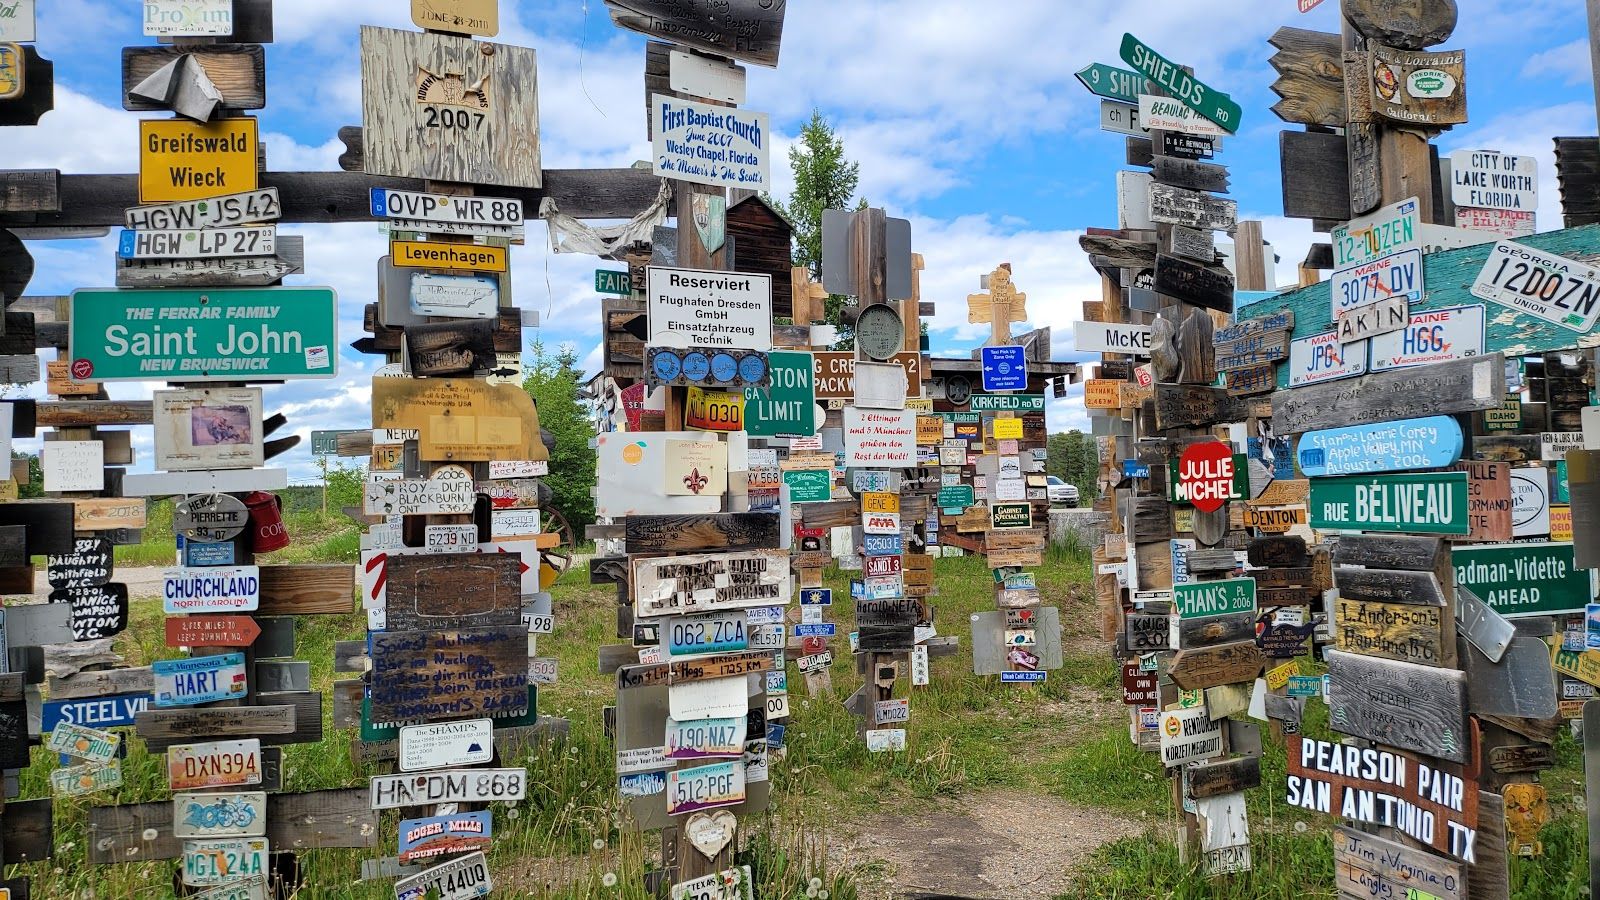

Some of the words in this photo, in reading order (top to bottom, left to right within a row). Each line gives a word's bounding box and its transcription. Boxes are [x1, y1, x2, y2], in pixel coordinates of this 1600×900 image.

[1404, 55, 1463, 67] Lorraine
[1091, 69, 1100, 84] 9
[1132, 44, 1205, 106] SHIELDS
[1216, 107, 1229, 122] RD
[423, 107, 486, 131] 2007
[1109, 109, 1122, 123] ch
[1151, 101, 1190, 120] BEAULAC
[662, 103, 685, 133] First
[687, 108, 724, 129] Baptist
[725, 115, 761, 150] Church
[149, 132, 247, 153] Greifswald
[685, 127, 705, 142] June
[707, 131, 733, 147] 2007
[1186, 140, 1211, 150] REYNOLDS
[666, 140, 695, 159] Wesley
[696, 145, 728, 163] Chapel,
[729, 150, 758, 166] Florida
[660, 155, 676, 171] The
[710, 164, 718, 178] &
[720, 166, 736, 180] The
[738, 168, 763, 184] Scott's
[1472, 153, 1499, 169] CITY
[1503, 156, 1518, 172] OF
[170, 167, 226, 187] Wieck
[1455, 170, 1487, 188] LAKE
[246, 193, 277, 218] 42
[388, 193, 437, 216] OVP
[453, 199, 486, 222] WR
[491, 201, 520, 223] 88
[1470, 190, 1521, 208] FLORIDA
[262, 229, 272, 237] 03
[136, 233, 183, 255] HGW
[199, 231, 228, 253] LP
[234, 230, 260, 252] 27
[405, 245, 496, 266] Levenhagen
[1497, 245, 1570, 273] GEORGIA
[1355, 258, 1391, 277] MAINE
[598, 272, 630, 292] FAIR
[669, 273, 751, 292] Reserviert
[1341, 271, 1379, 307] 3077
[1390, 262, 1414, 293] DV
[659, 295, 714, 308] Flughafen
[717, 298, 762, 310] Dresden
[1513, 297, 1548, 314] UNION
[125, 308, 155, 320] THE
[158, 307, 222, 321] FERRAR
[225, 306, 281, 319] FAMILY
[695, 310, 728, 320] GmbH
[1341, 304, 1403, 338] AKIN
[667, 321, 755, 335] Einsatzfahrzeug
[104, 324, 197, 356] Saint
[216, 324, 303, 355] John
[691, 334, 733, 345] Technik
[1403, 325, 1444, 355] HGG
[139, 359, 176, 372] NEW
[183, 358, 271, 371] BRUNSWICK
[908, 359, 917, 373] 2
[1392, 354, 1453, 365] Vacationland
[1305, 369, 1346, 381] Vacationland
[758, 401, 803, 422] LIMIT
[971, 396, 1019, 409] KIRKFIELD
[709, 403, 740, 424] 030
[861, 413, 866, 421] 2
[867, 413, 901, 424] Ettringer
[955, 414, 978, 422] Alabama
[1490, 412, 1516, 420] IDAHO
[850, 427, 866, 435] und
[873, 426, 912, 435] Münchner
[1360, 430, 1398, 443] Laurie
[1399, 424, 1438, 445] Corey
[1542, 433, 1553, 443] KEN
[1553, 434, 1558, 443] &
[1558, 433, 1571, 443] LOIS
[888, 440, 903, 448] den
[1328, 448, 1361, 463] Apple
[1400, 440, 1424, 453] MN
[854, 452, 872, 460] Rest
[873, 452, 886, 460] der
[886, 451, 909, 460] Welt!
[1326, 459, 1371, 475] August
[1394, 454, 1432, 468] 2006
[436, 470, 466, 480] 2006
[761, 472, 779, 484] 568
[1179, 458, 1233, 480] JULIE
[1175, 479, 1242, 501] MICHEL
[1517, 485, 1534, 493] TOM
[398, 505, 421, 514] ONT
[867, 498, 886, 510] GENE
[891, 499, 896, 511] 3
[1323, 503, 1350, 522] RUE
[1355, 479, 1453, 525] BÉLIVEAU
[191, 512, 239, 523] PIERRETTE
[492, 516, 534, 525] PROFILE
[1251, 510, 1298, 525] DENTON
[196, 527, 209, 537] 93
[215, 530, 226, 539] 07
[428, 533, 457, 545] 6239
[461, 532, 475, 544] ND
[867, 538, 892, 551] 52503
[894, 537, 900, 549] E
[215, 569, 235, 578] Flight
[868, 560, 891, 573] SANDI
[894, 560, 900, 571] 3
[165, 576, 258, 599] CHURCHLAND
[173, 600, 204, 608] NORTH
[206, 598, 249, 607] CAROLINA
[1174, 587, 1228, 614] CHAN'S
[1236, 586, 1245, 596] PL
[1232, 594, 1251, 609] 2006
[1486, 588, 1540, 607] AHEAD
[534, 616, 551, 631] 98
[674, 625, 705, 646] 062
[713, 621, 745, 643] ZCA
[175, 659, 222, 671] Minnesota
[720, 664, 741, 675] 1725
[746, 661, 762, 672] KM
[174, 669, 220, 696] HART
[768, 677, 784, 689] 638
[1136, 680, 1151, 689] OWN
[1307, 680, 1320, 690] 900
[428, 723, 478, 736] SHAMPS
[708, 726, 736, 748] NAZ
[185, 751, 256, 779] DXN394
[1301, 738, 1406, 788] PEARSON
[1418, 764, 1464, 813] PAIR
[476, 773, 521, 798] 868
[677, 781, 704, 803] 512
[708, 773, 735, 797] PGF
[1286, 775, 1331, 814] SAN
[1341, 788, 1435, 845] ANTONIO
[1447, 819, 1477, 865] TX
[407, 822, 444, 843] ROGER
[449, 820, 483, 833] MILLS
[201, 842, 243, 850] FLORIDA
[408, 848, 445, 859] COUNTY
[186, 852, 217, 877] WGI
[227, 851, 262, 875] 24A
[1349, 839, 1376, 862] Jim
[1385, 848, 1440, 885] Virginia
[416, 861, 465, 884] GEORGIA
[1348, 865, 1393, 898] Langley
